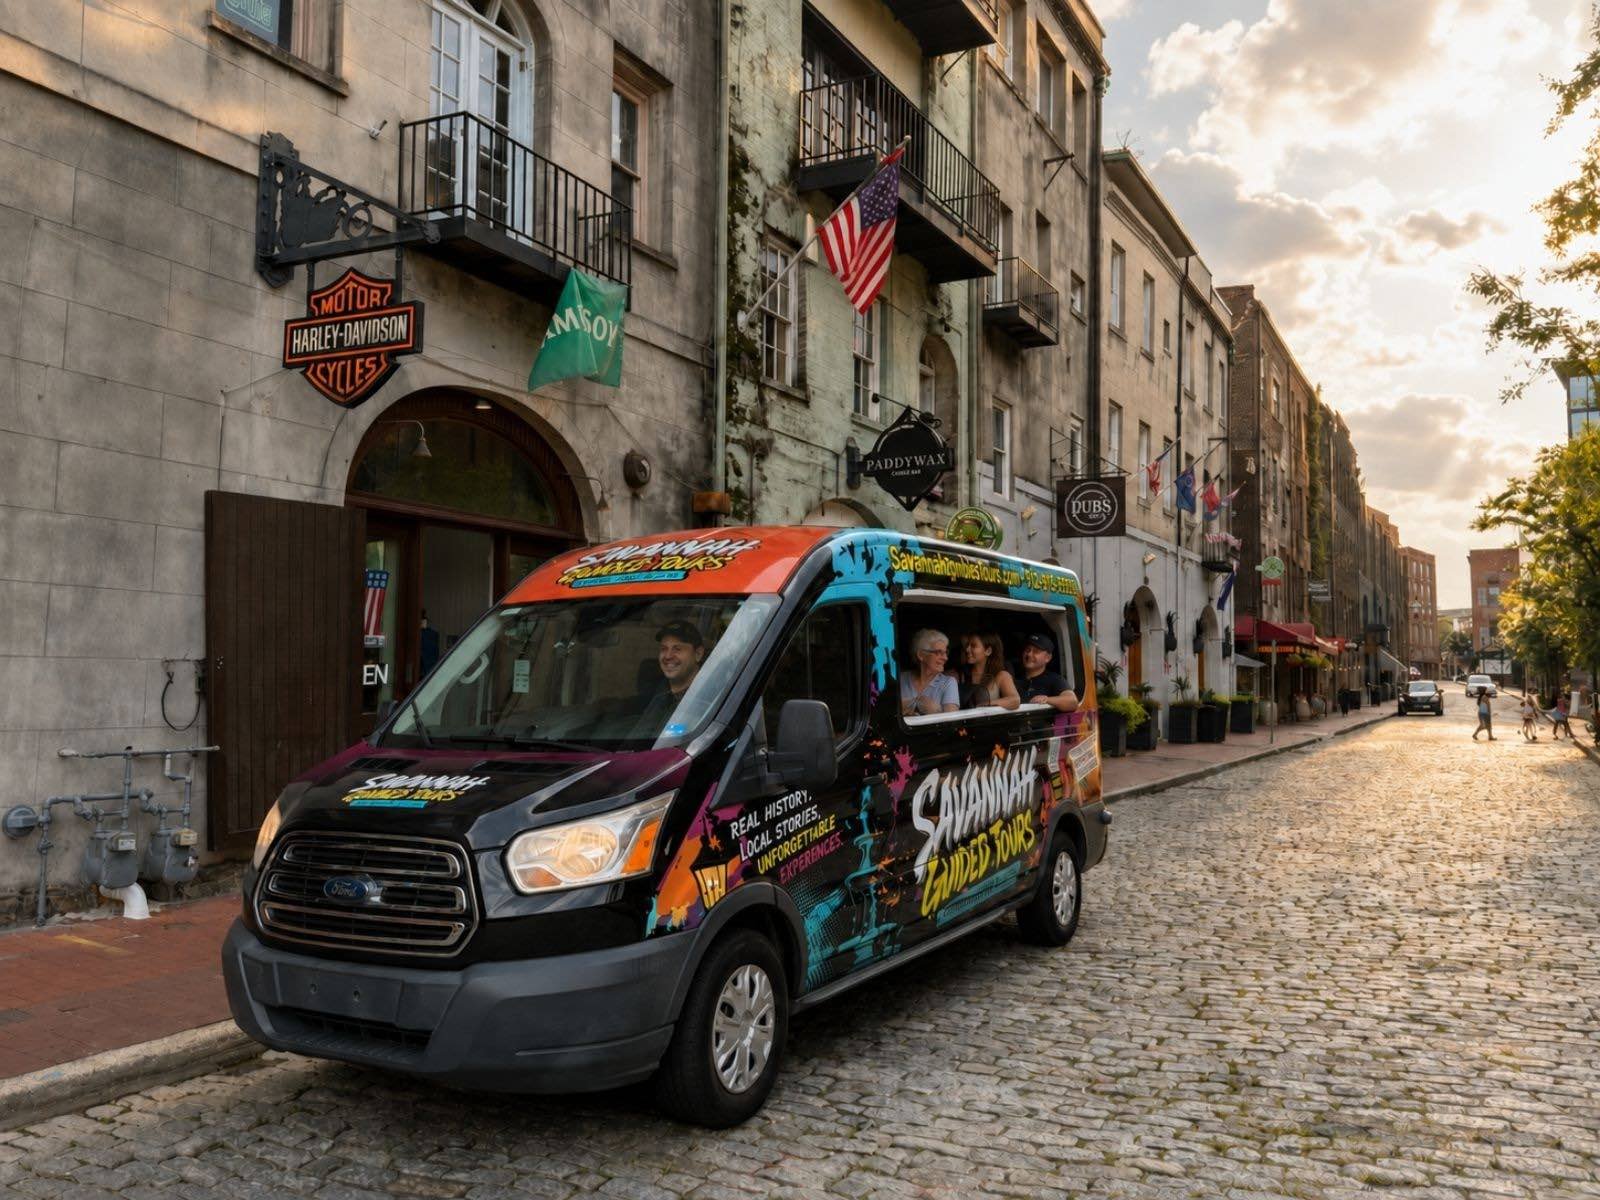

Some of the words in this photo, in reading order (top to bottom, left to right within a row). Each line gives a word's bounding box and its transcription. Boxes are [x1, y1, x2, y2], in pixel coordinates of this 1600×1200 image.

[321, 280, 381, 315] MOTOR
[291, 313, 409, 355] HARLEY-DAVIDSON
[316, 355, 378, 394] CYCLES
[865, 452, 946, 472] PADDYWAX
[729, 810, 760, 840] REAL
[912, 744, 1039, 885] SAVANNAH
[739, 830, 773, 862] LOCAL
[757, 813, 836, 875] UNFORGETTABLE
[988, 808, 1036, 870] TOURS
